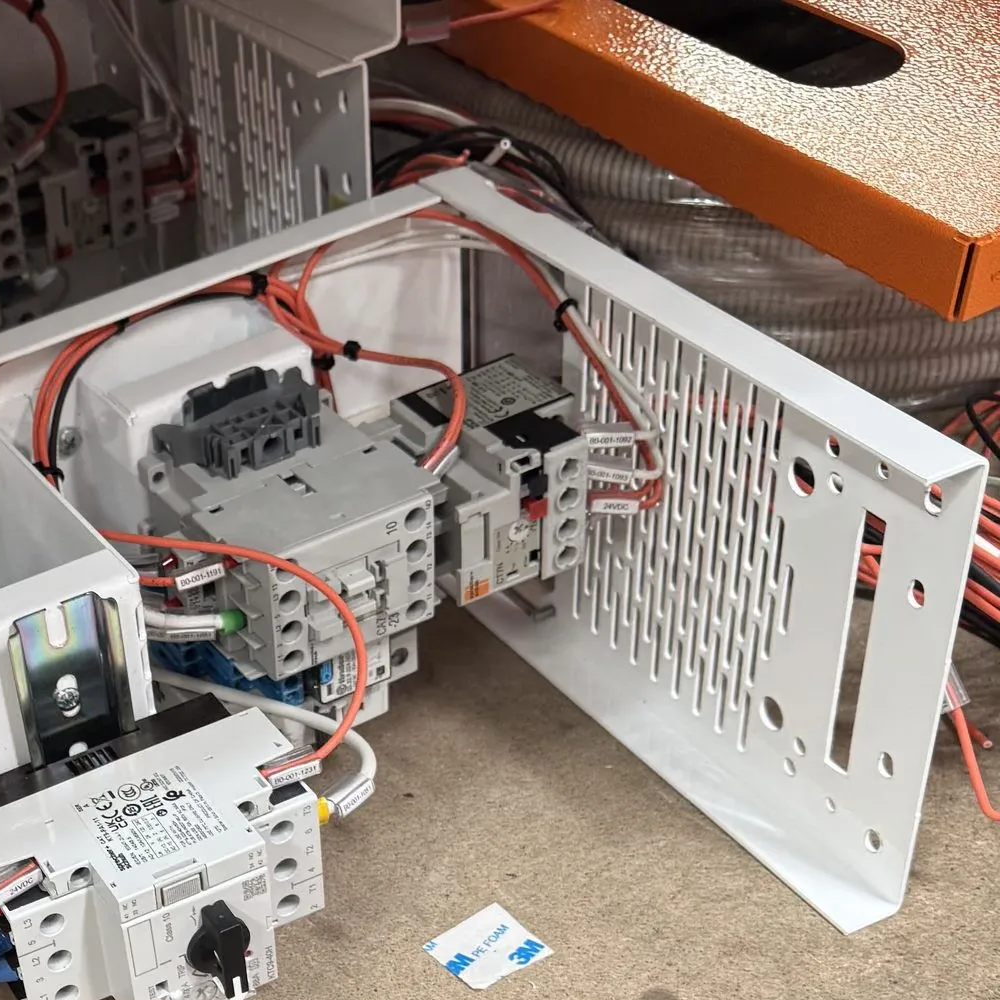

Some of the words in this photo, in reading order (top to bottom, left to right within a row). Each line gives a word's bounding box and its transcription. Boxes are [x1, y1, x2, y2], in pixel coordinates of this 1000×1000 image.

[385, 520, 399, 536] 10
[302, 804, 312, 817] T3
[305, 844, 315, 857] T2
[8, 876, 34, 896] 24VDC
[161, 912, 171, 921] 10
[23, 918, 33, 930] L3
[164, 920, 174, 943] Class
[471, 945, 487, 958] PE
[482, 923, 510, 947] FOAM
[507, 938, 546, 966] 3M
[31, 955, 41, 967] L2
